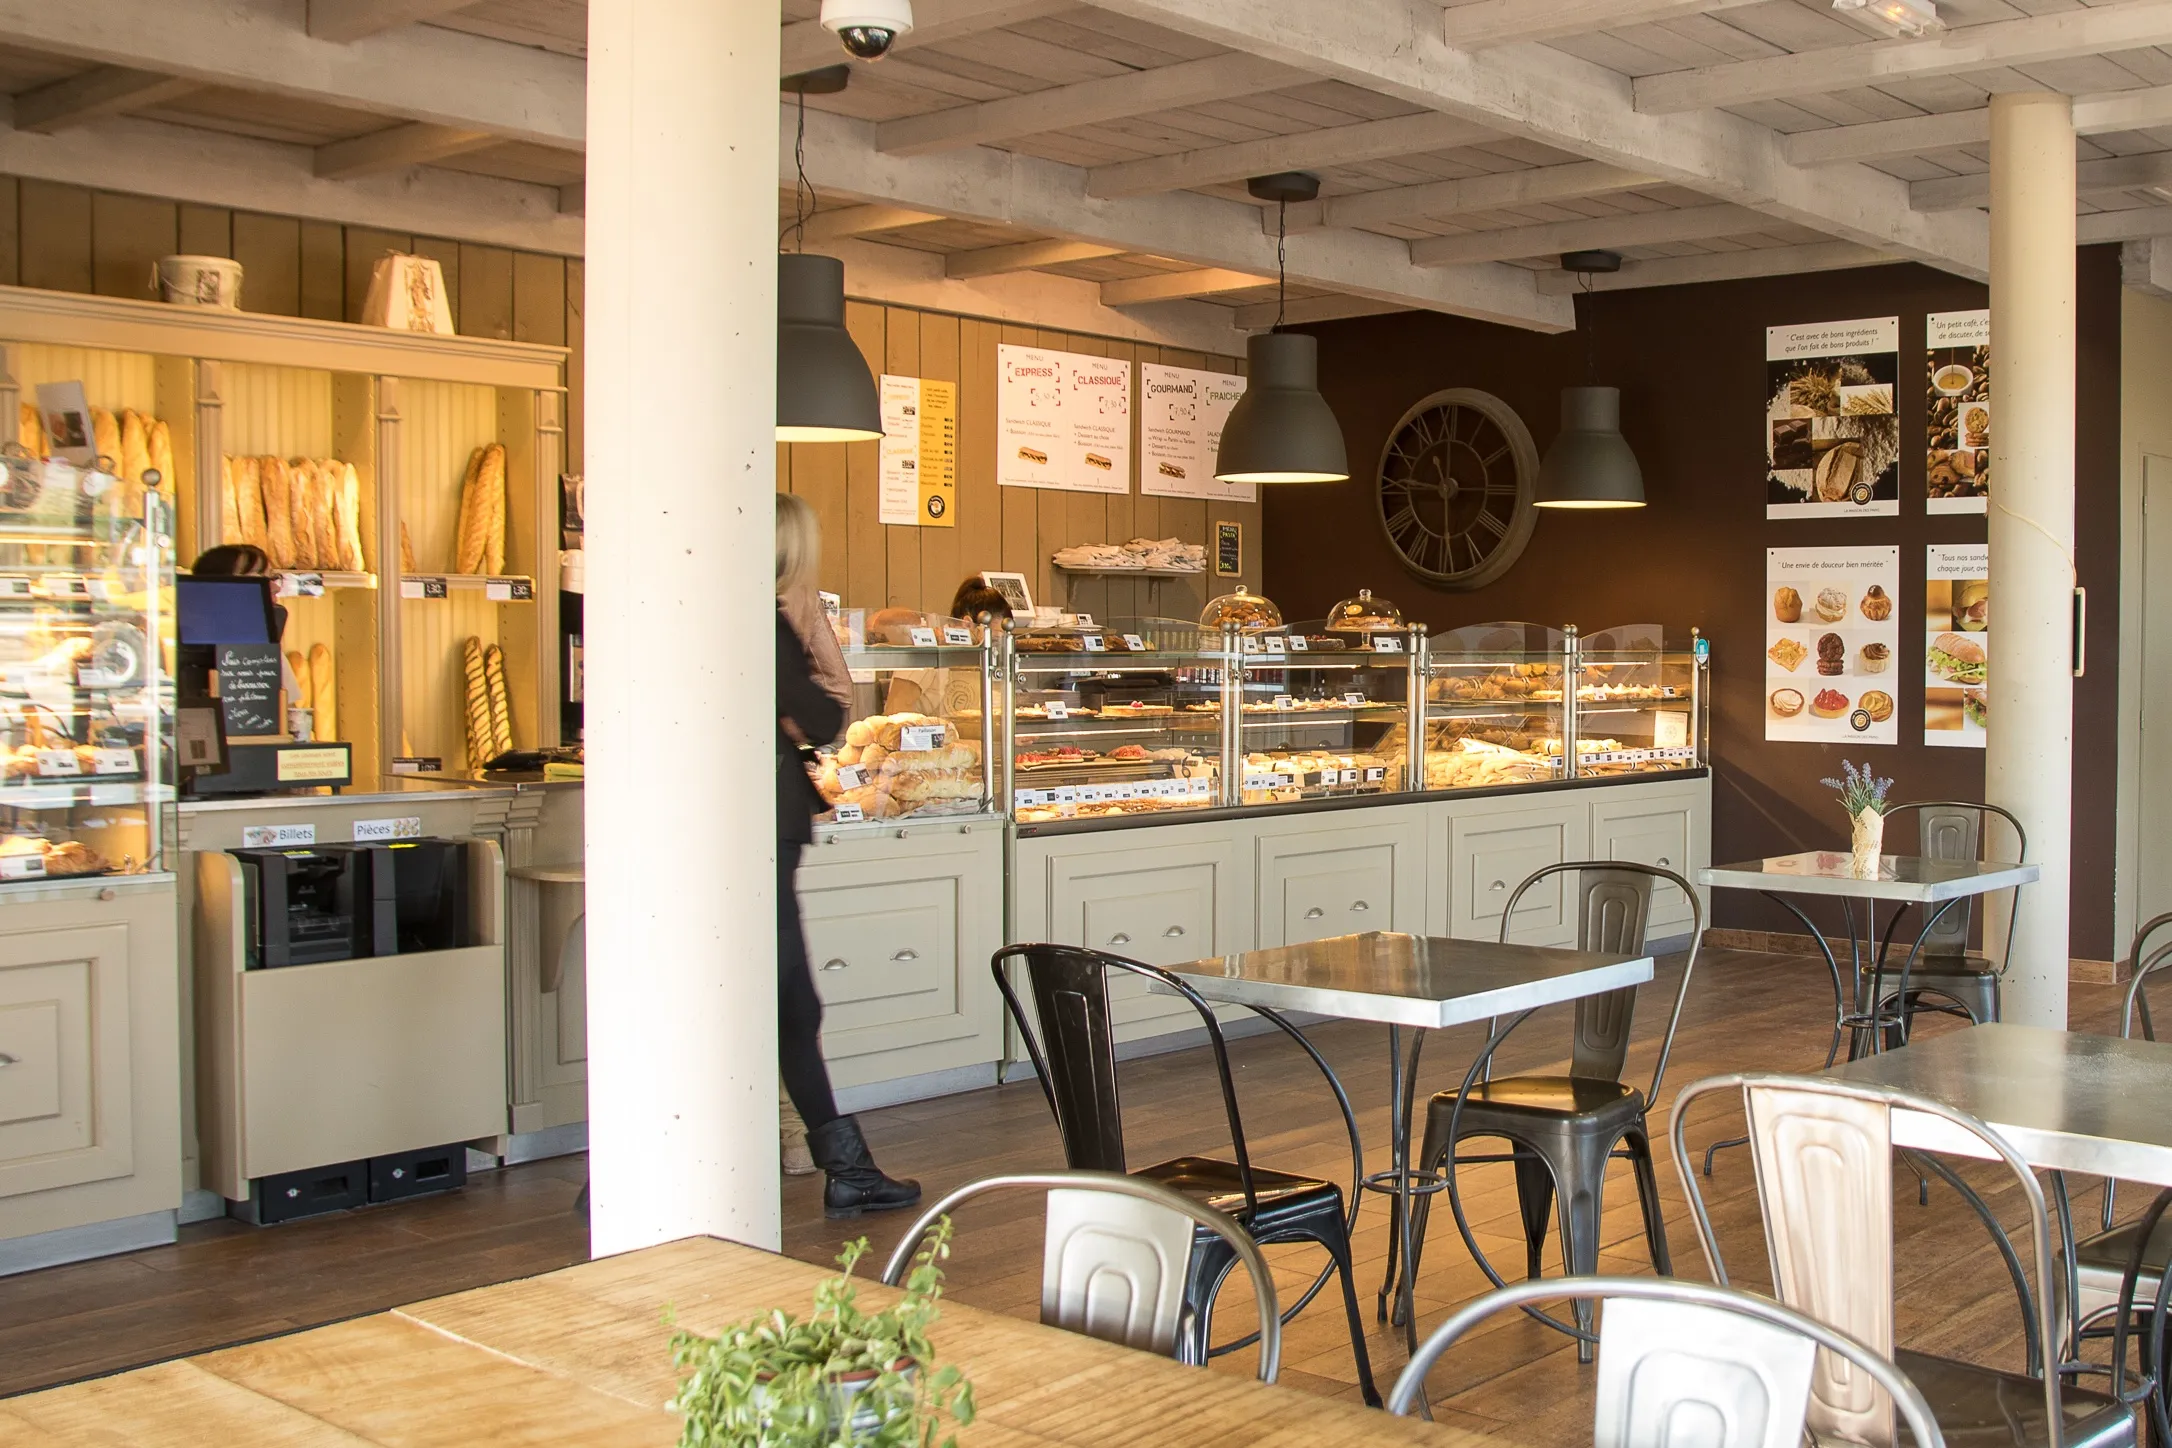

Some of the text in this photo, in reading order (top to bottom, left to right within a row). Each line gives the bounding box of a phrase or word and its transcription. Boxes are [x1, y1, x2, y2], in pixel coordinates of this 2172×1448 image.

[1948, 320, 1962, 329] petit
[1846, 329, 1878, 338] ingrédients
[1809, 342, 1819, 351] fait
[1845, 339, 1869, 348] produits
[1015, 368, 1053, 377] EXPRESS
[1077, 376, 1121, 385] CLASSIQUE
[1150, 384, 1193, 394] GOURMAND
[1210, 391, 1243, 400] FRAICHE
[1026, 420, 1051, 428] CLASSIQUE
[1166, 428, 1191, 436] GOURMAND
[1937, 565, 1960, 573] chaque
[279, 829, 313, 839] Billets
[357, 825, 391, 835] Pièces
